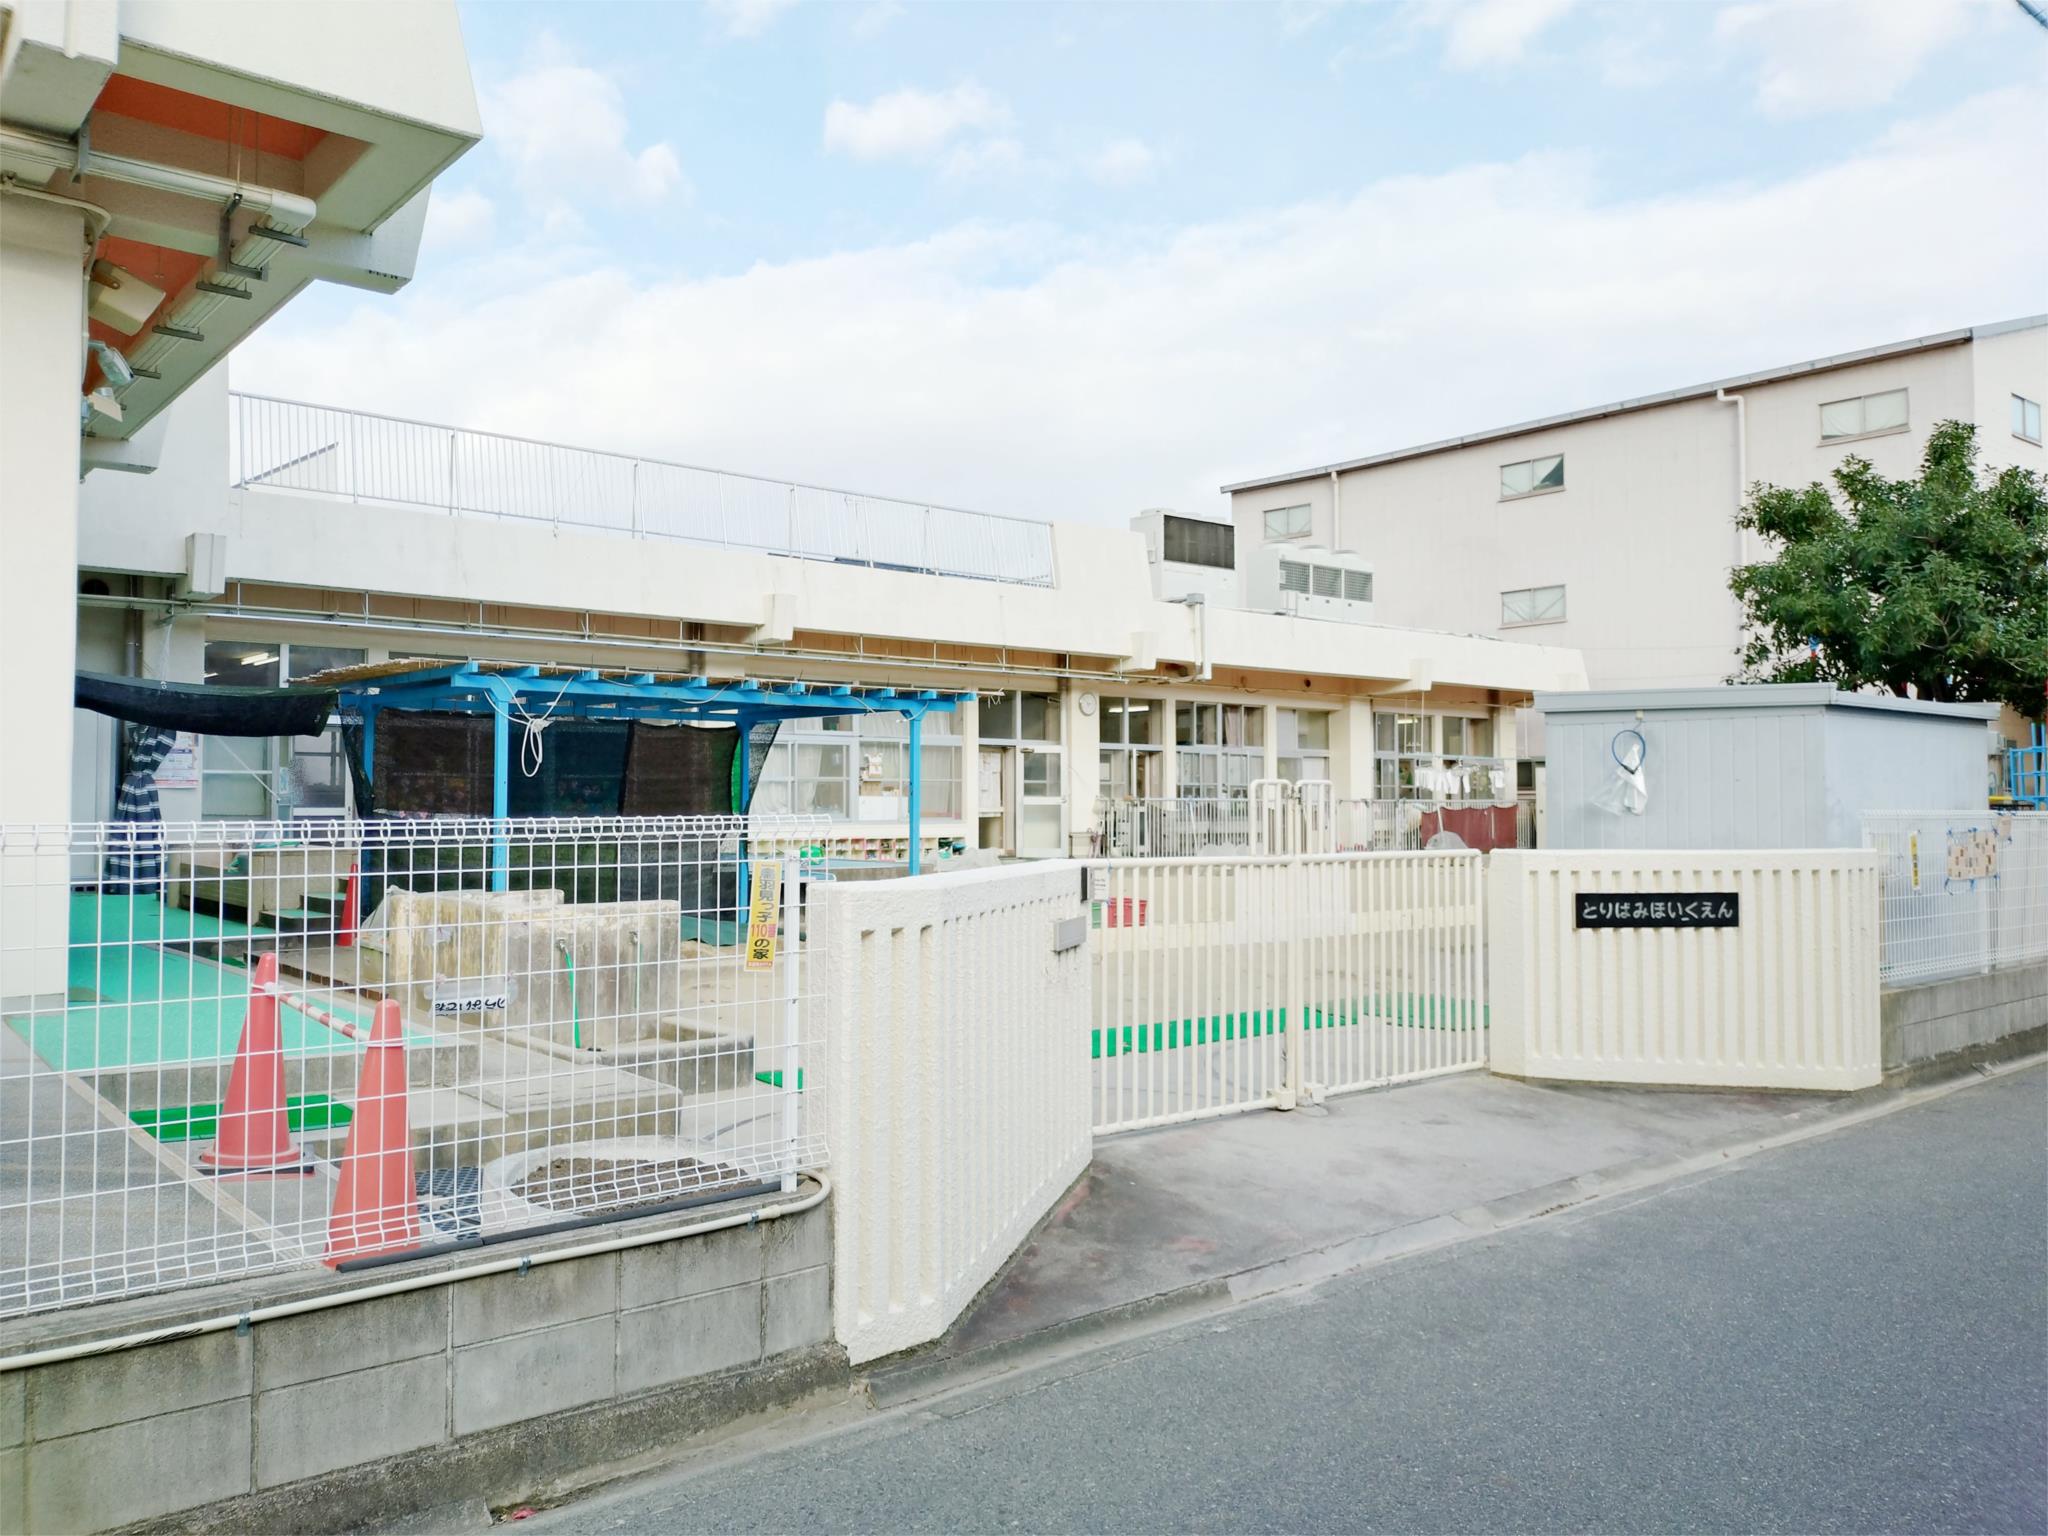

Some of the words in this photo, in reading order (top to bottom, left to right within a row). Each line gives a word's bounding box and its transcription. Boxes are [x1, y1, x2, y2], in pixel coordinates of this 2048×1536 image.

[1582, 901, 1733, 920] とりばみほいくえん
